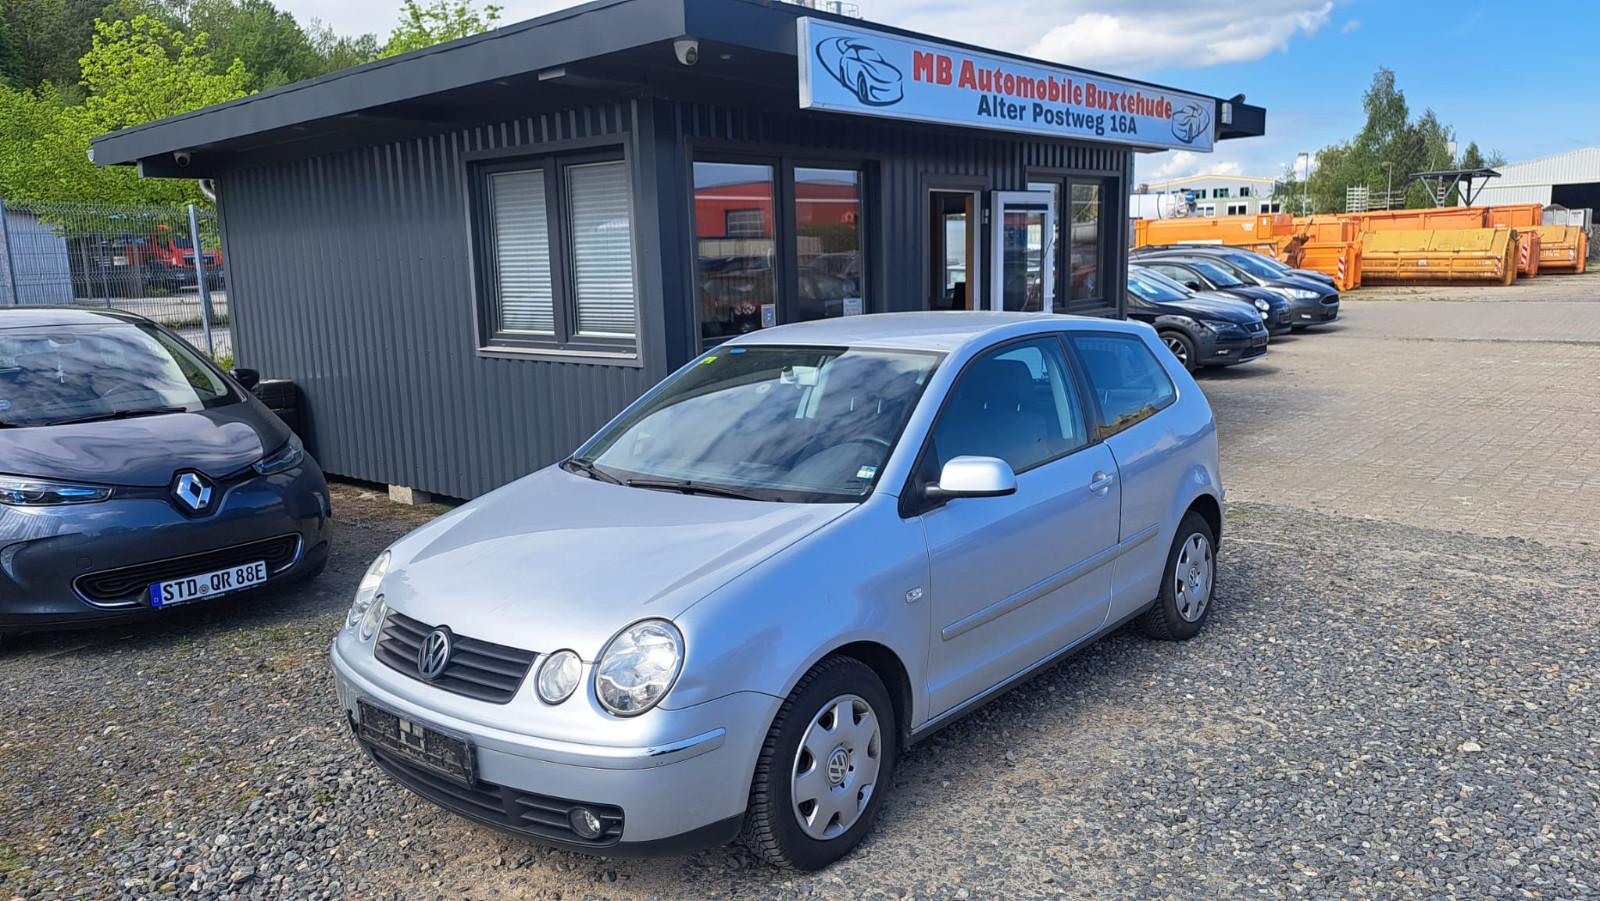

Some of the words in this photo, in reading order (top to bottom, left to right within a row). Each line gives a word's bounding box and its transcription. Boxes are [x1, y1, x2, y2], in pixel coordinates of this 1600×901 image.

[913, 50, 953, 86] MB
[958, 59, 1082, 106] Automobile
[1085, 82, 1172, 119] Buxtehude
[977, 94, 1026, 121] Alter
[1033, 102, 1105, 136] Postweg
[1110, 114, 1137, 135] 16A
[163, 578, 198, 601] STD
[210, 570, 232, 591] QR
[236, 563, 265, 585] 88E
